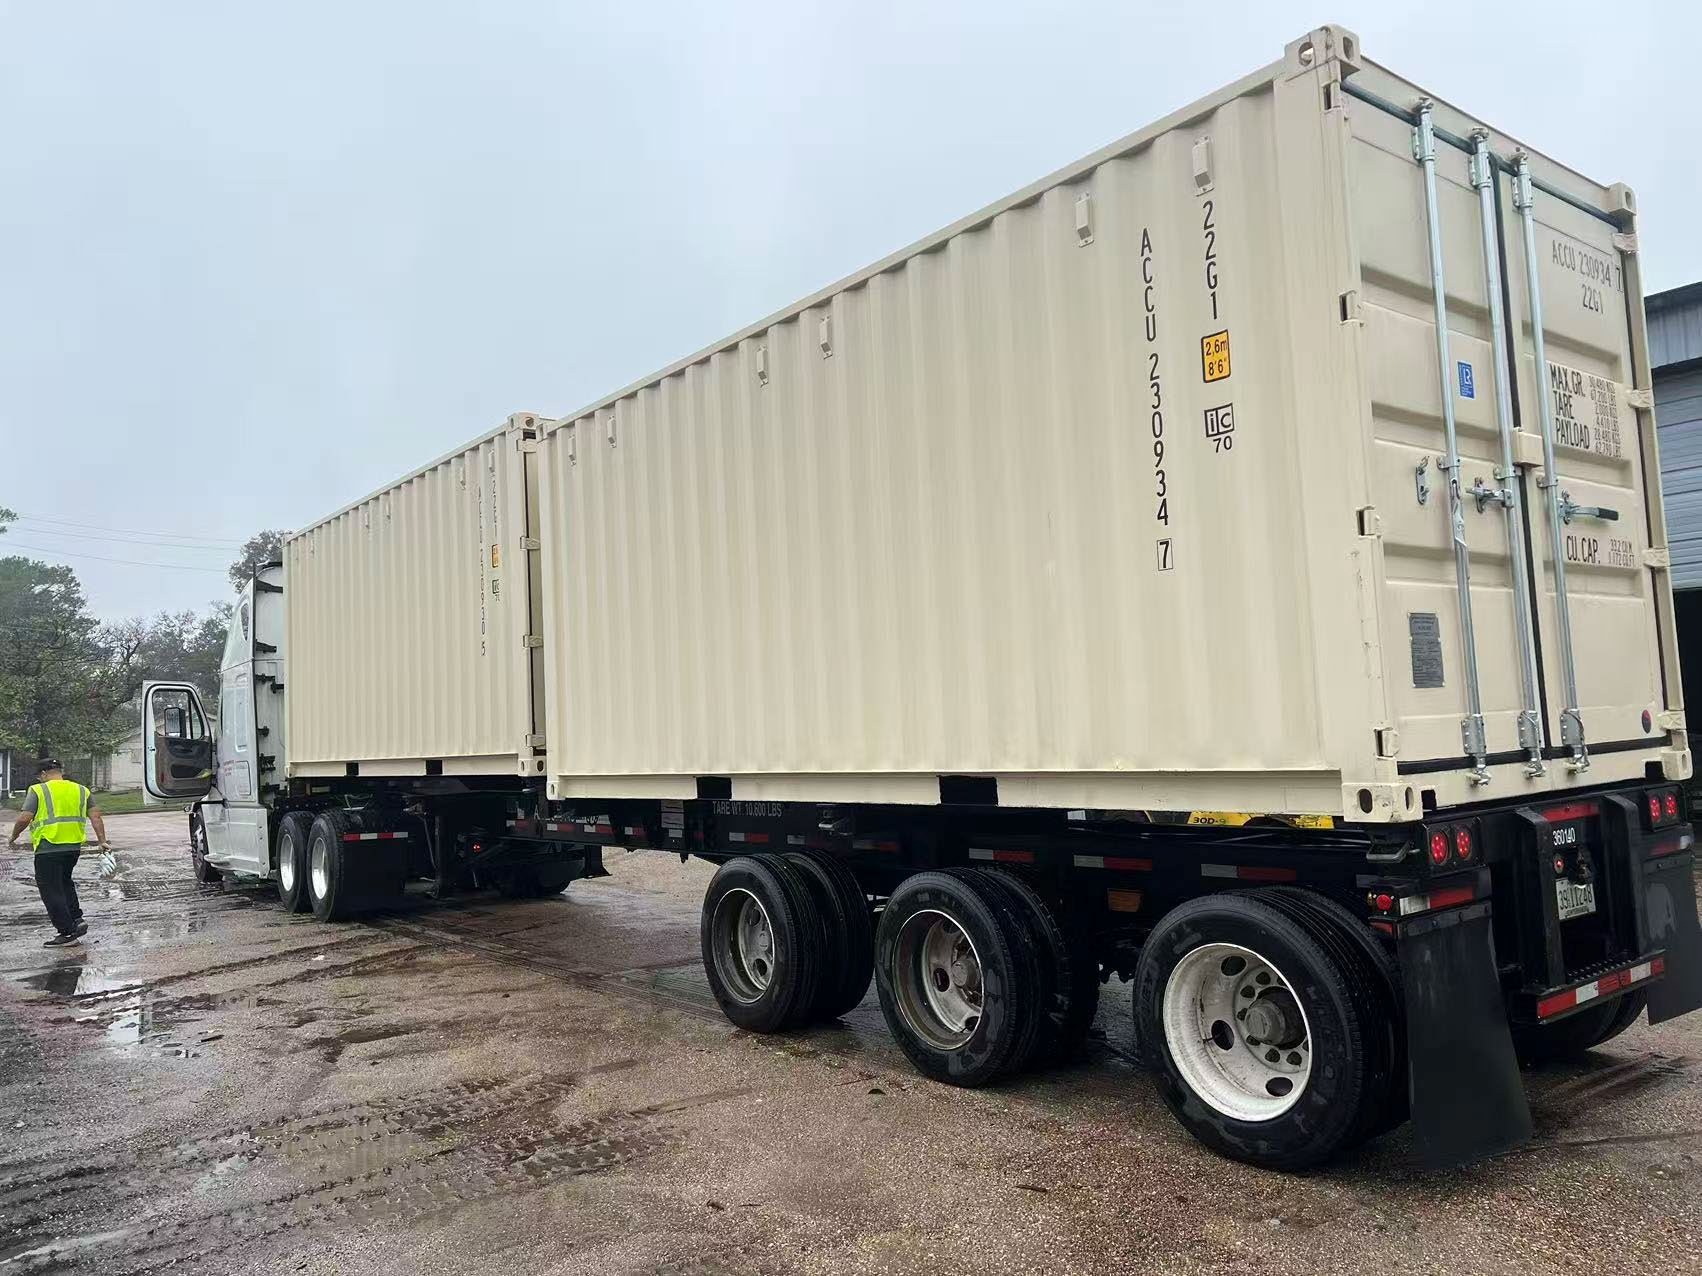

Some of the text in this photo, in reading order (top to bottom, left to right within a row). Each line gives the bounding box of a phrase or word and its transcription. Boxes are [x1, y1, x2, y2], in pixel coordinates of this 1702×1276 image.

[1202, 200, 1218, 320] 22G1
[1552, 239, 1576, 271] ACCU
[1578, 250, 1612, 287] 230934
[1140, 226, 1170, 569] ACCU 230934 7
[1553, 390, 1575, 419] TARE
[1213, 435, 1232, 453] 70
[1555, 417, 1590, 449] PAYLOAD
[712, 801, 730, 815] TARE
[767, 803, 782, 817] LBS
[1552, 827, 1576, 846] 360140
